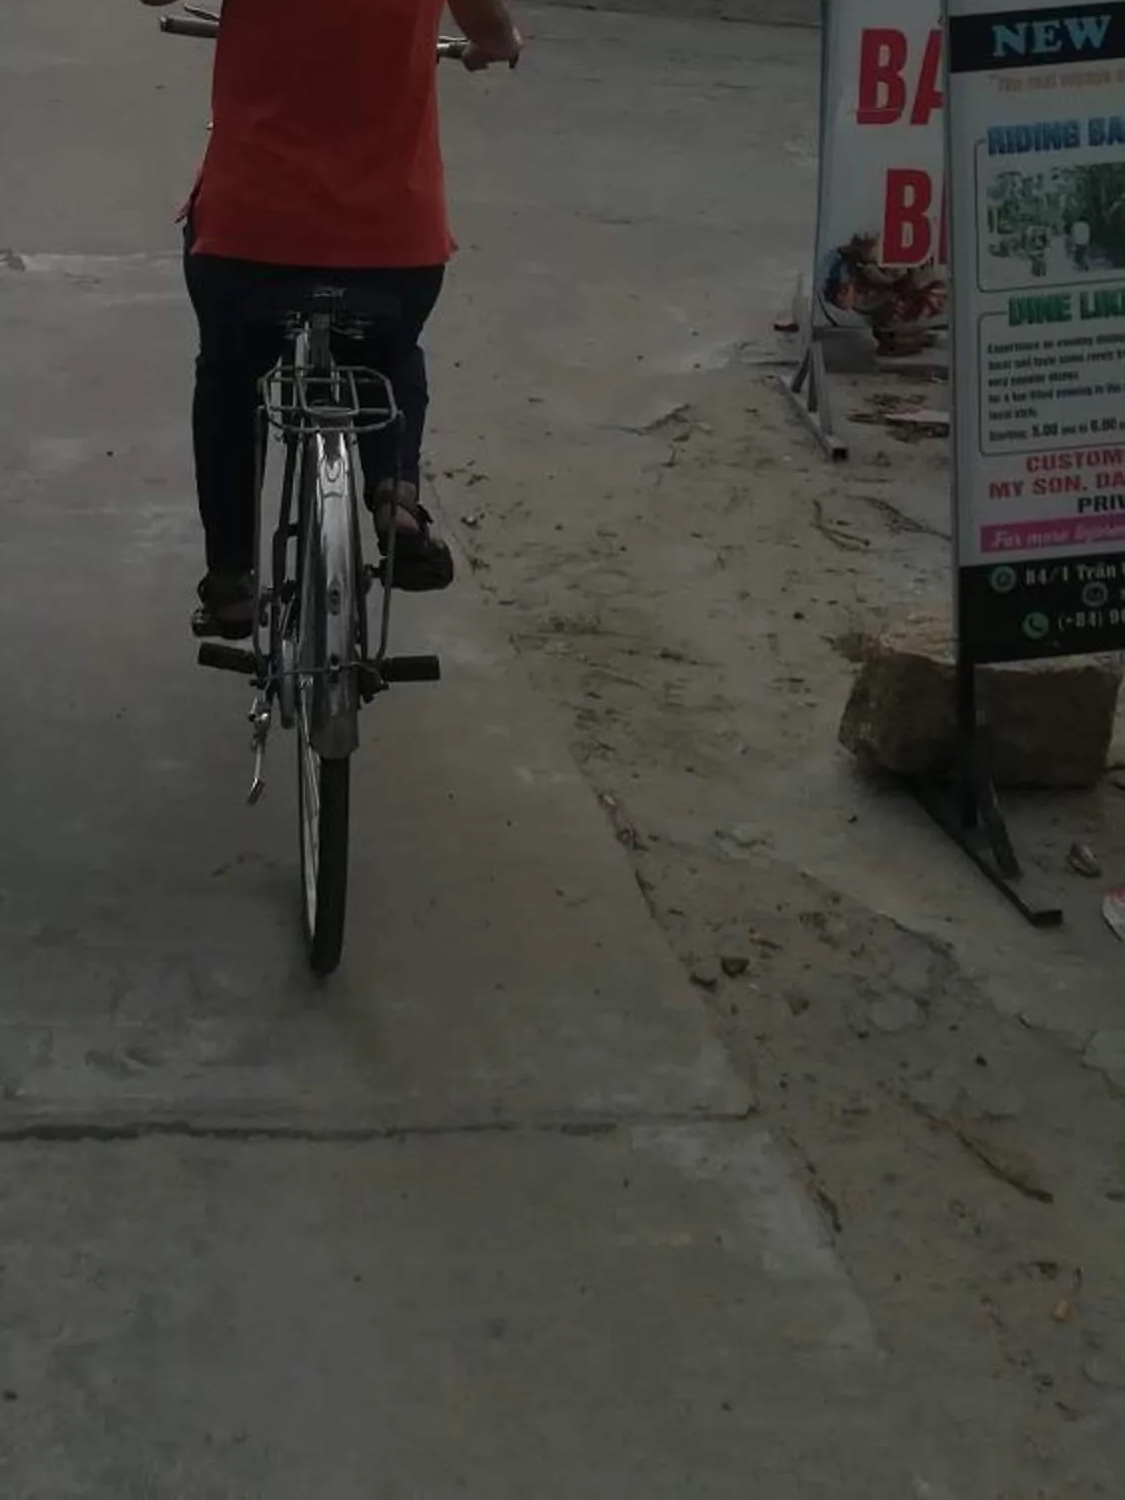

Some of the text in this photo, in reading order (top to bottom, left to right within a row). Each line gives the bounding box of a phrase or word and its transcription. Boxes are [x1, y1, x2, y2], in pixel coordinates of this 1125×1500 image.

[991, 15, 1112, 58] NEW
[988, 120, 1080, 156] RIDING
[883, 167, 948, 266] B
[1009, 293, 1072, 327] DINE
[1026, 449, 1123, 473] CUSTOM
[988, 480, 1024, 499] MY
